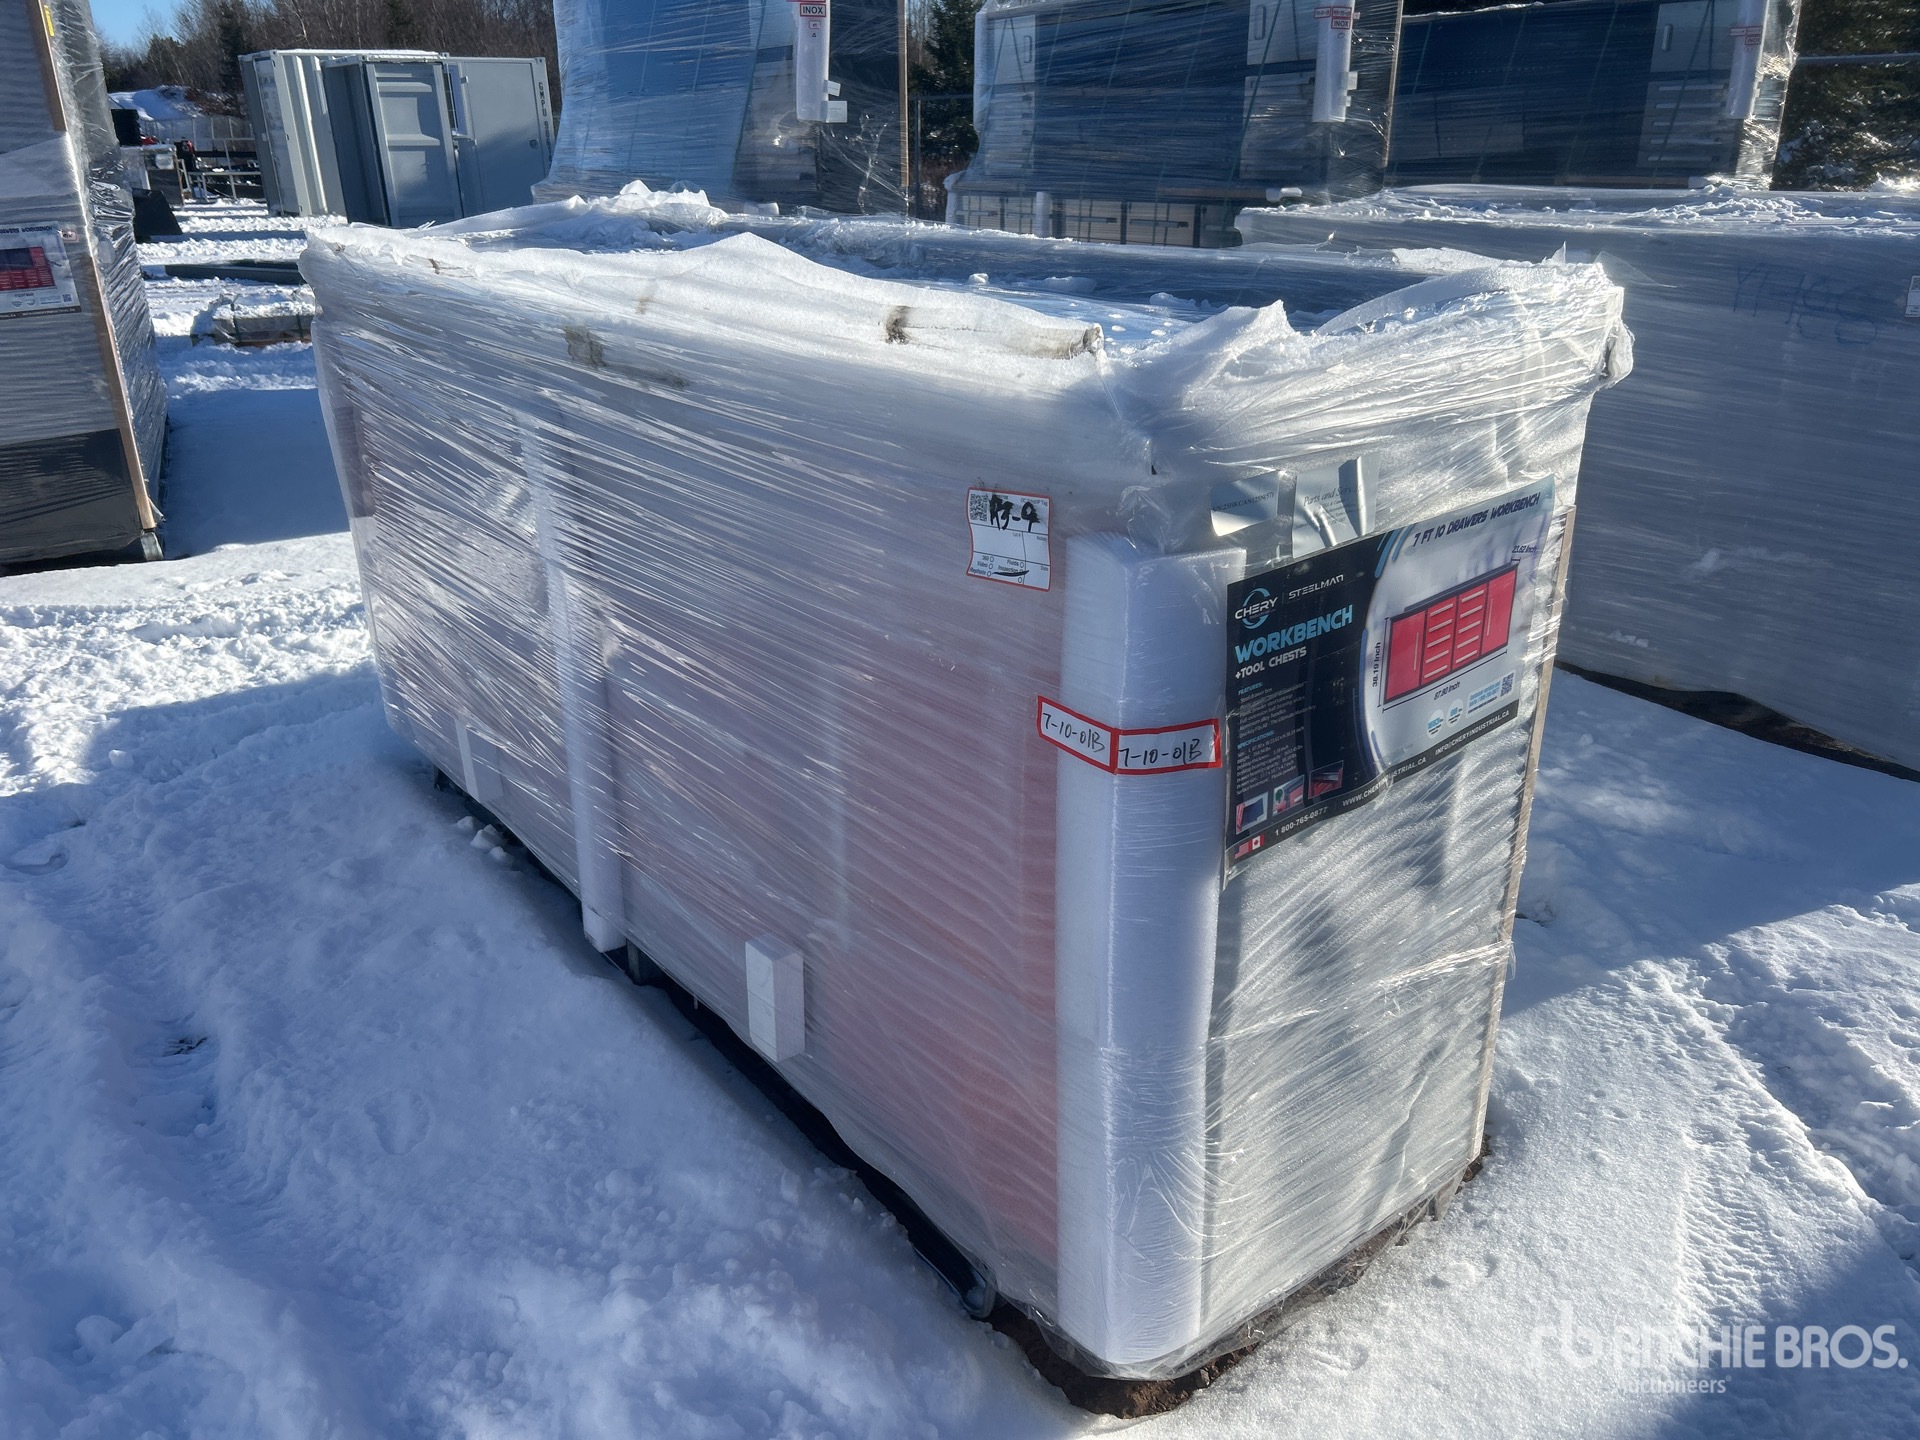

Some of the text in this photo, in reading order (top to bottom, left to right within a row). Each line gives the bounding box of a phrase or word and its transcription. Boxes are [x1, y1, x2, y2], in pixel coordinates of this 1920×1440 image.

[802, 6, 824, 15] INOX
[538, 82, 547, 117] GMPU
[1303, 495, 1320, 507] Parts
[1321, 487, 1336, 501] and
[1412, 532, 1421, 547] 7
[1421, 527, 1434, 544] FT
[1445, 508, 1489, 535] DRAWERS
[1490, 492, 1541, 520] WORKBENCH
[1288, 574, 1344, 600] STEELMAN
[1234, 597, 1279, 619] CHERY
[1234, 604, 1353, 664] WORKBENCH
[1268, 646, 1307, 667] CHESTS
[1342, 756, 1427, 807] WWW.CHERYUSTRIAL.CA
